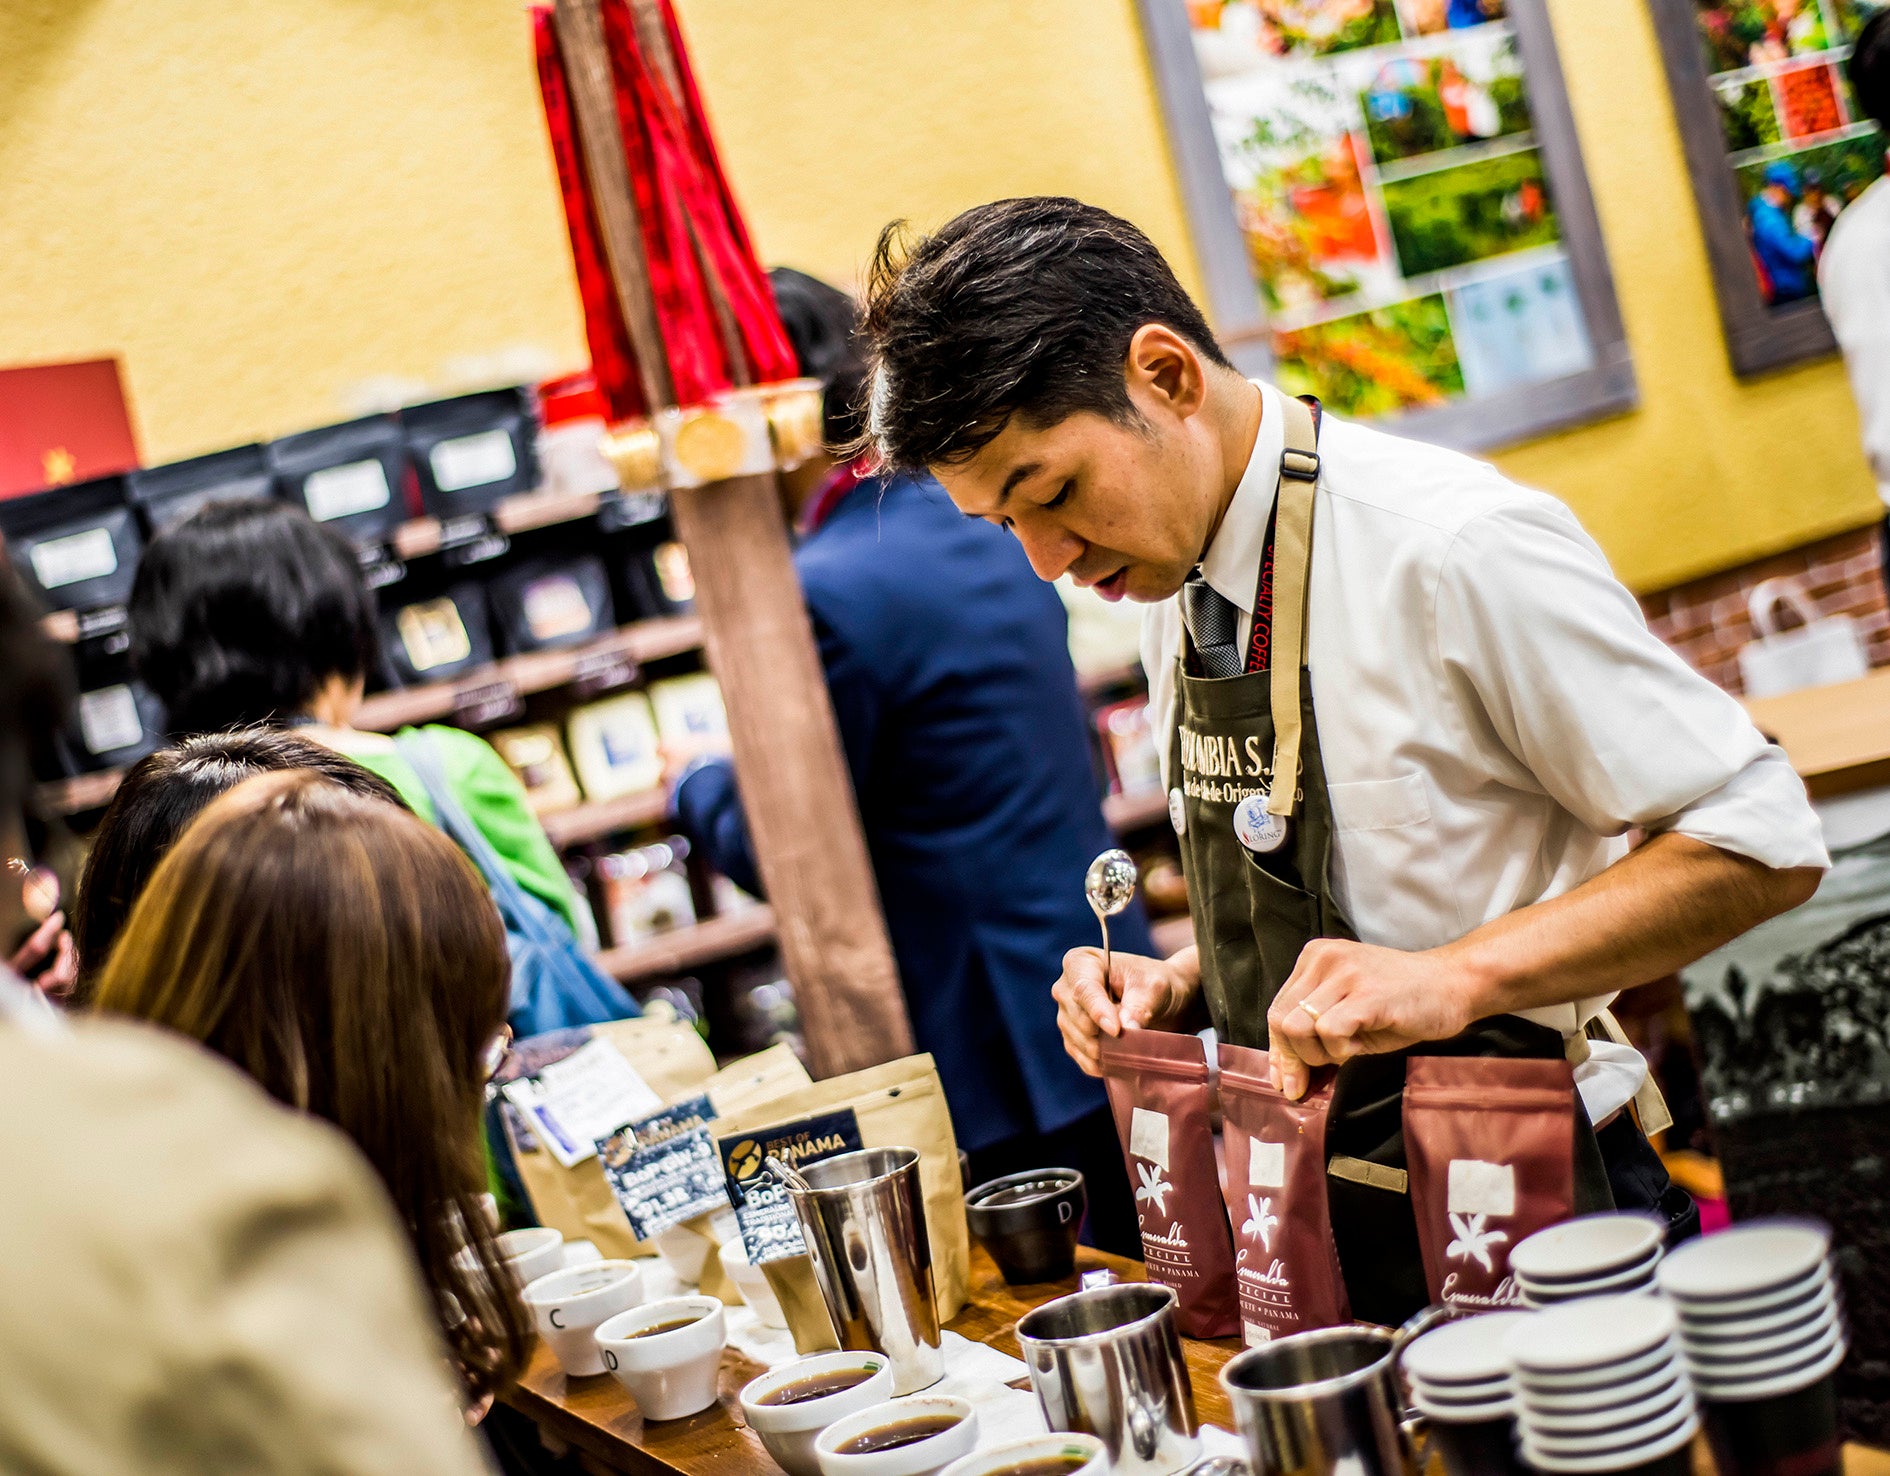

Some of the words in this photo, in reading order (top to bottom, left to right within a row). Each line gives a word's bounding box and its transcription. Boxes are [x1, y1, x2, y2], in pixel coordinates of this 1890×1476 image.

[765, 1136, 793, 1150] BEST
[795, 1131, 811, 1143] OF
[1058, 1201, 1073, 1224] D
[1143, 1246, 1190, 1263] PECIAL
[1167, 1267, 1200, 1278] PANAMA
[1239, 1283, 1290, 1304] PECIAL
[549, 1308, 566, 1330] C
[1264, 1307, 1299, 1320] PANAMA
[604, 1350, 619, 1372] D
